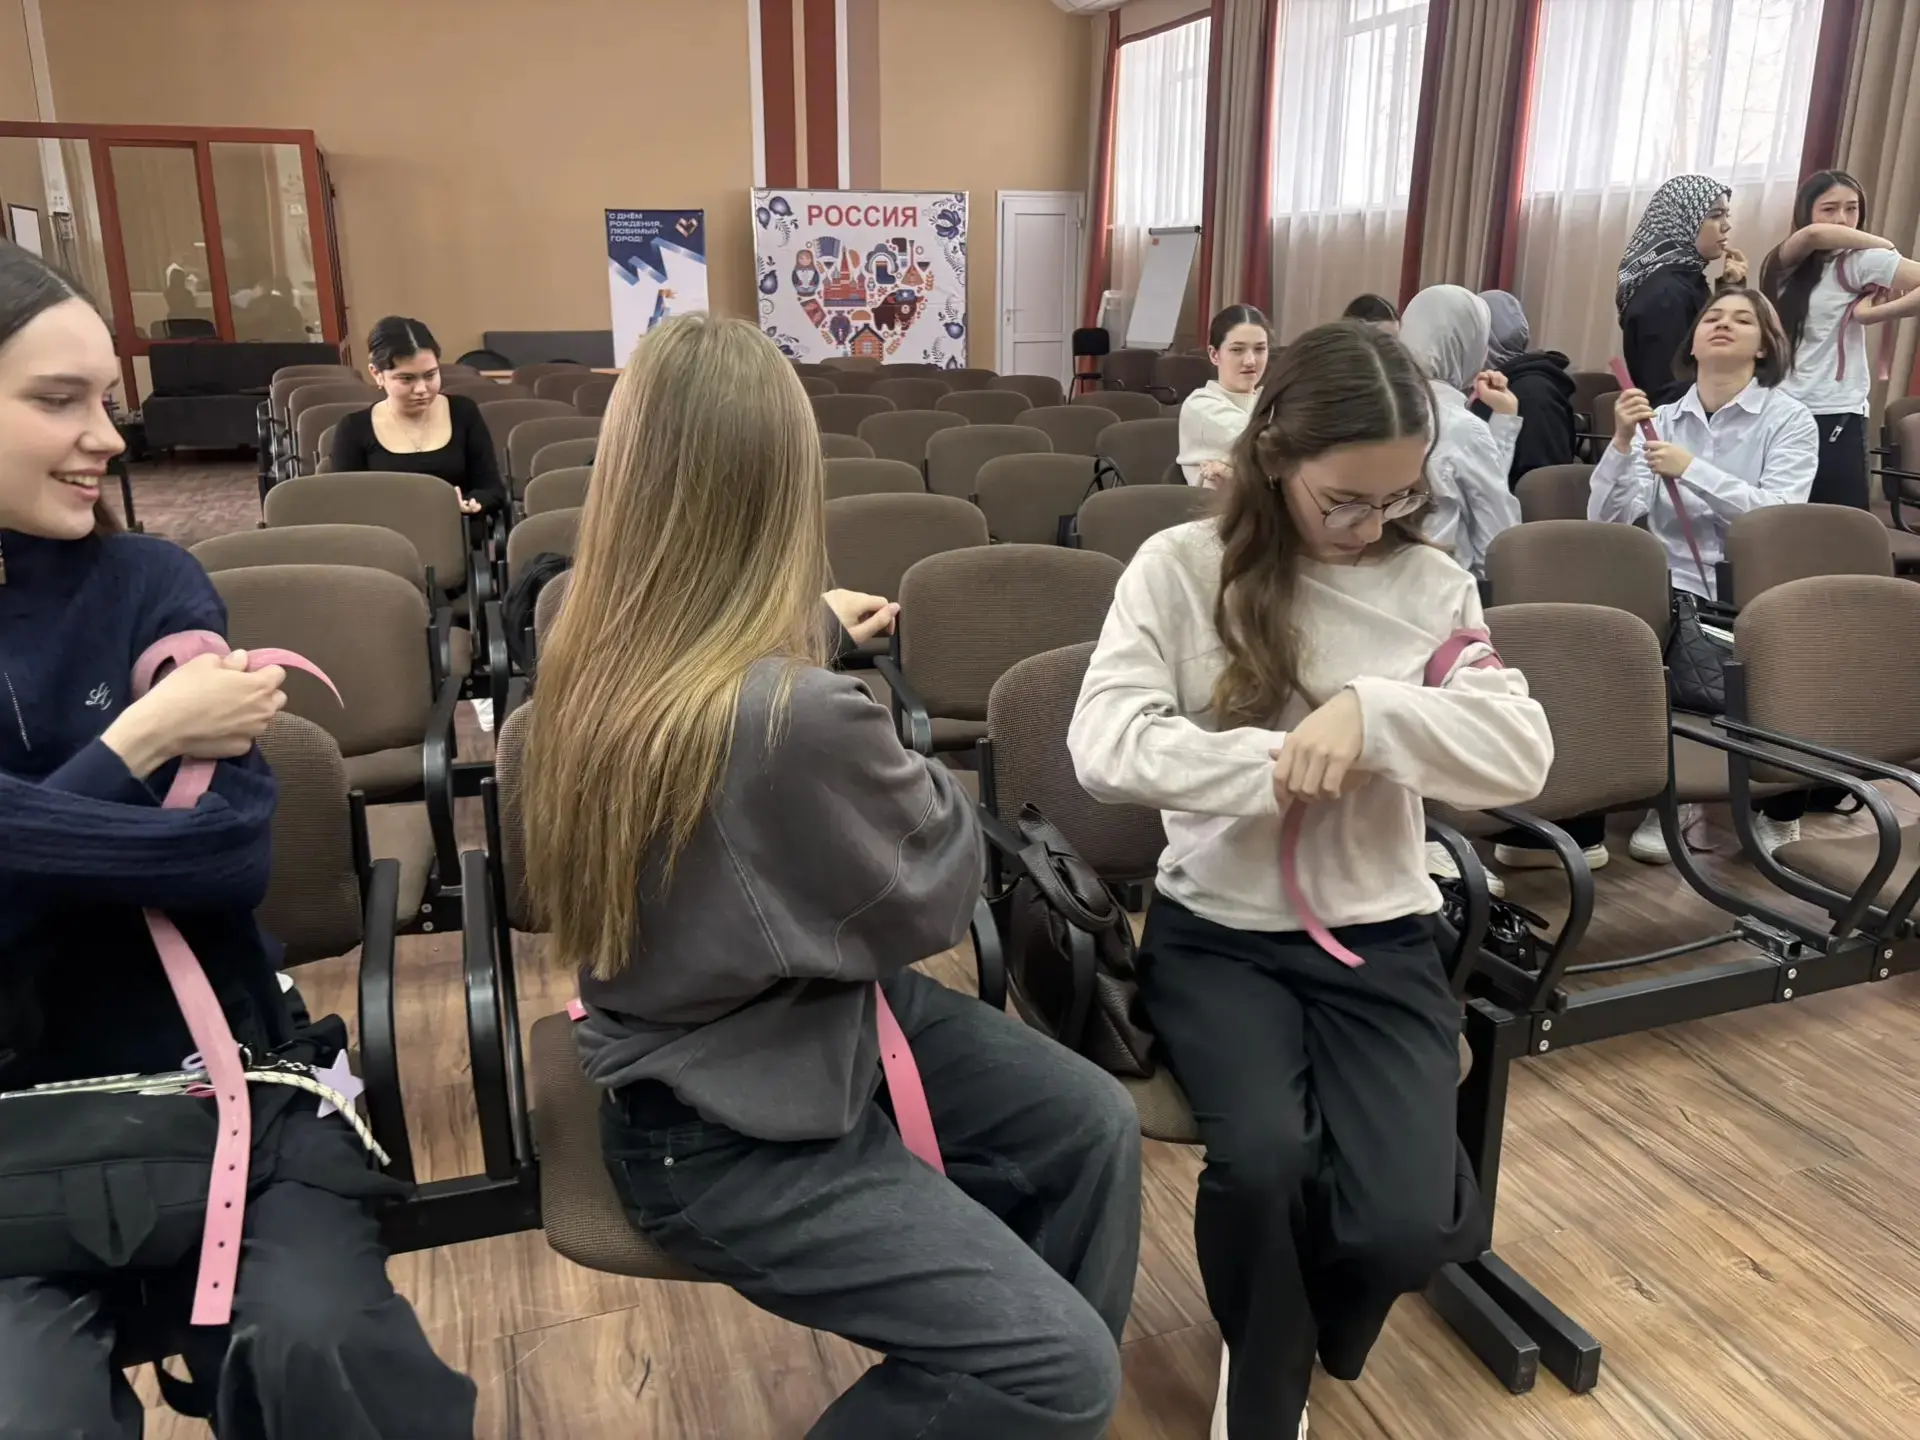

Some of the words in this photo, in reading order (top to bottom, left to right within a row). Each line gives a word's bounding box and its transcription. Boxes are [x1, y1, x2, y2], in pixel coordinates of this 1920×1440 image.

[617, 211, 643, 220] ДНЁМ
[807, 205, 917, 227] РОССИЯ
[609, 220, 663, 228] РОЖДЕНИЯ,
[610, 227, 659, 235] ЛЮБИМЫЙ
[1640, 250, 1657, 265] DIOR
